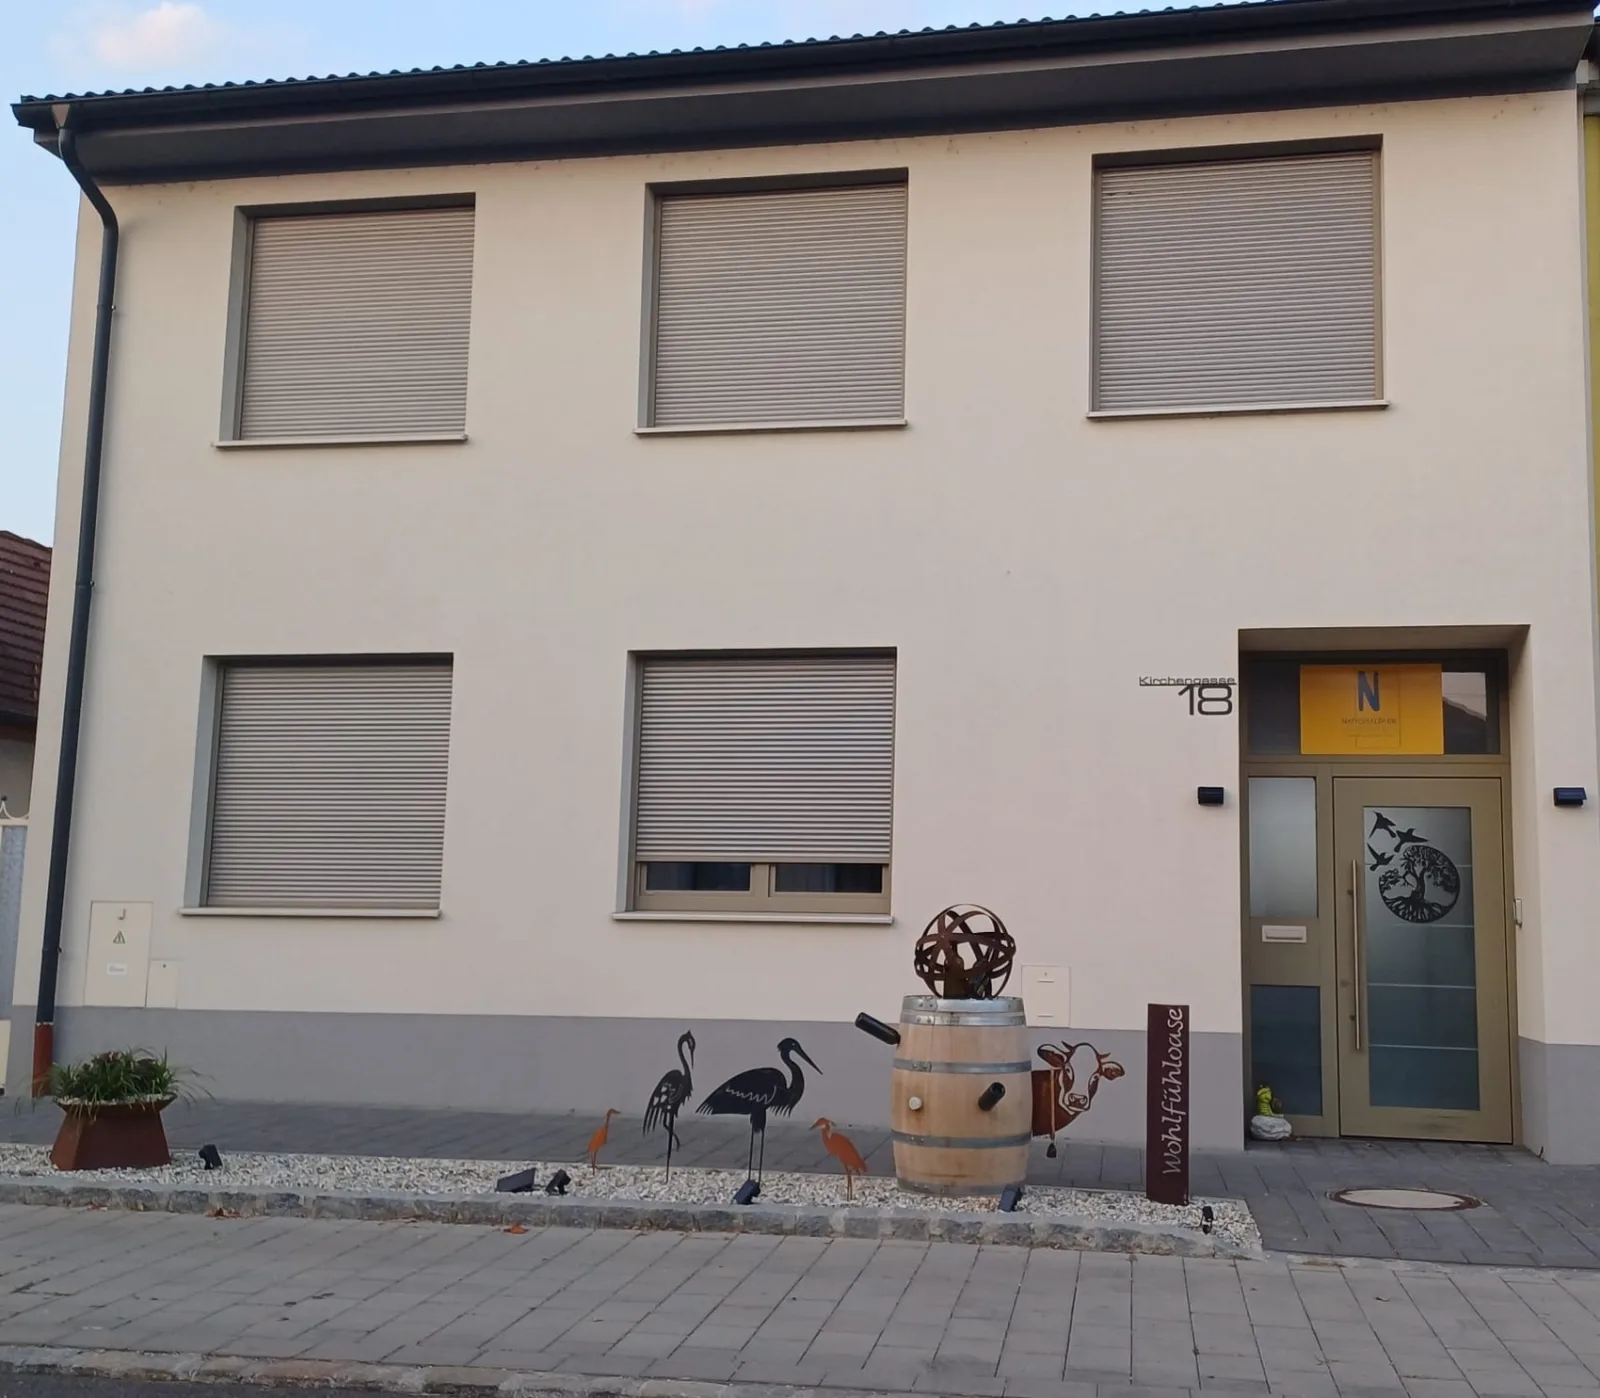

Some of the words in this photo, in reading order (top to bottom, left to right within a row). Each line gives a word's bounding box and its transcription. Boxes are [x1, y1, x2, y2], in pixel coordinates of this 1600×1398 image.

[1178, 684, 1233, 716] 18
[1357, 670, 1381, 712] N
[1161, 1007, 1187, 1175] Wohlfühloase
